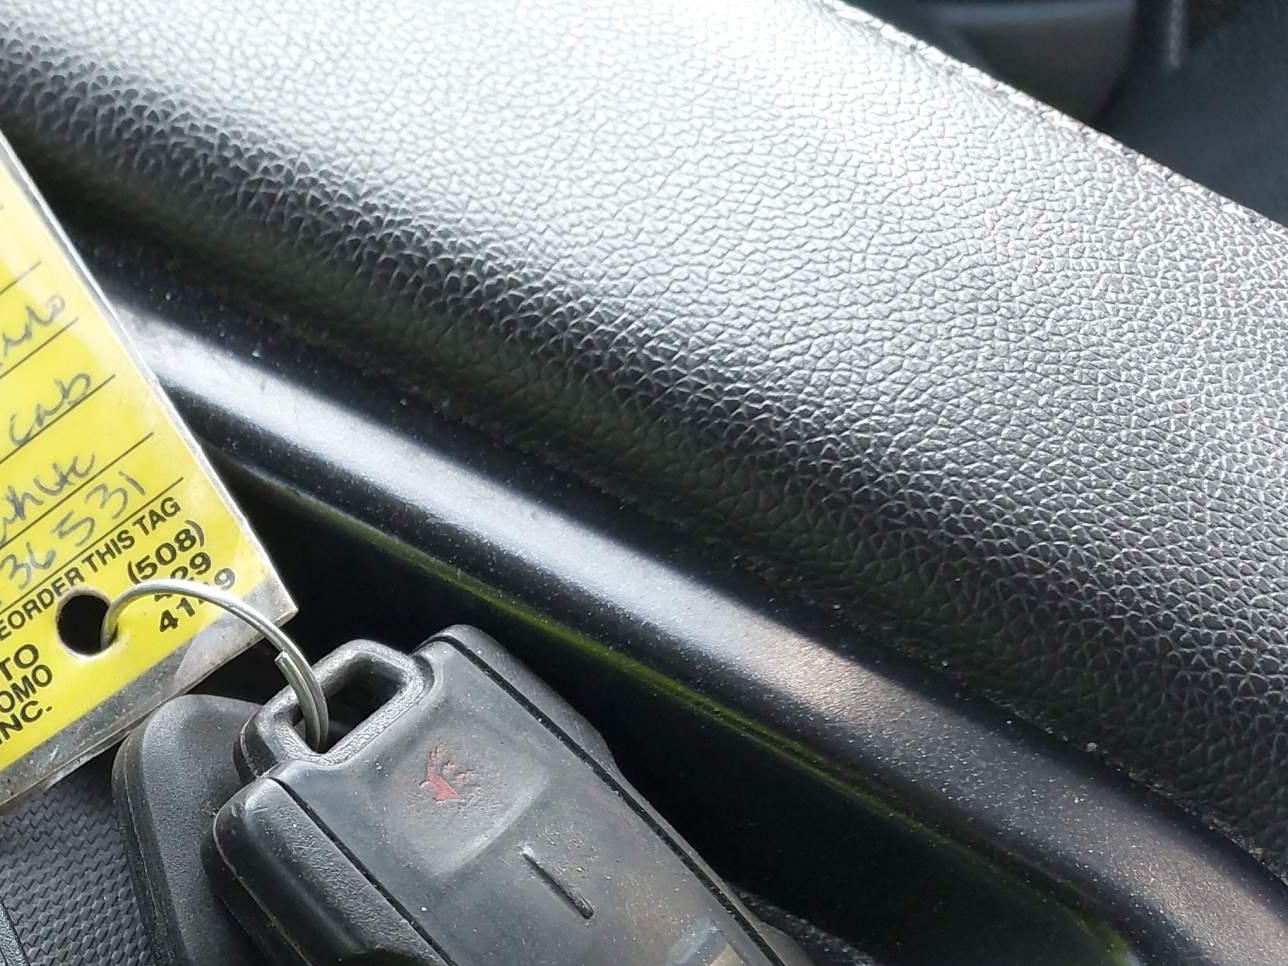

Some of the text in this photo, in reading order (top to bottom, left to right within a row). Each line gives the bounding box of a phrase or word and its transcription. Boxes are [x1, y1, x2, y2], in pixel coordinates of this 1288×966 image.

[81, 528, 136, 574] THIS
[132, 497, 182, 537] TAG
[127, 519, 205, 586] (508)
[154, 552, 211, 602] 29
[160, 567, 236, 632] 419
